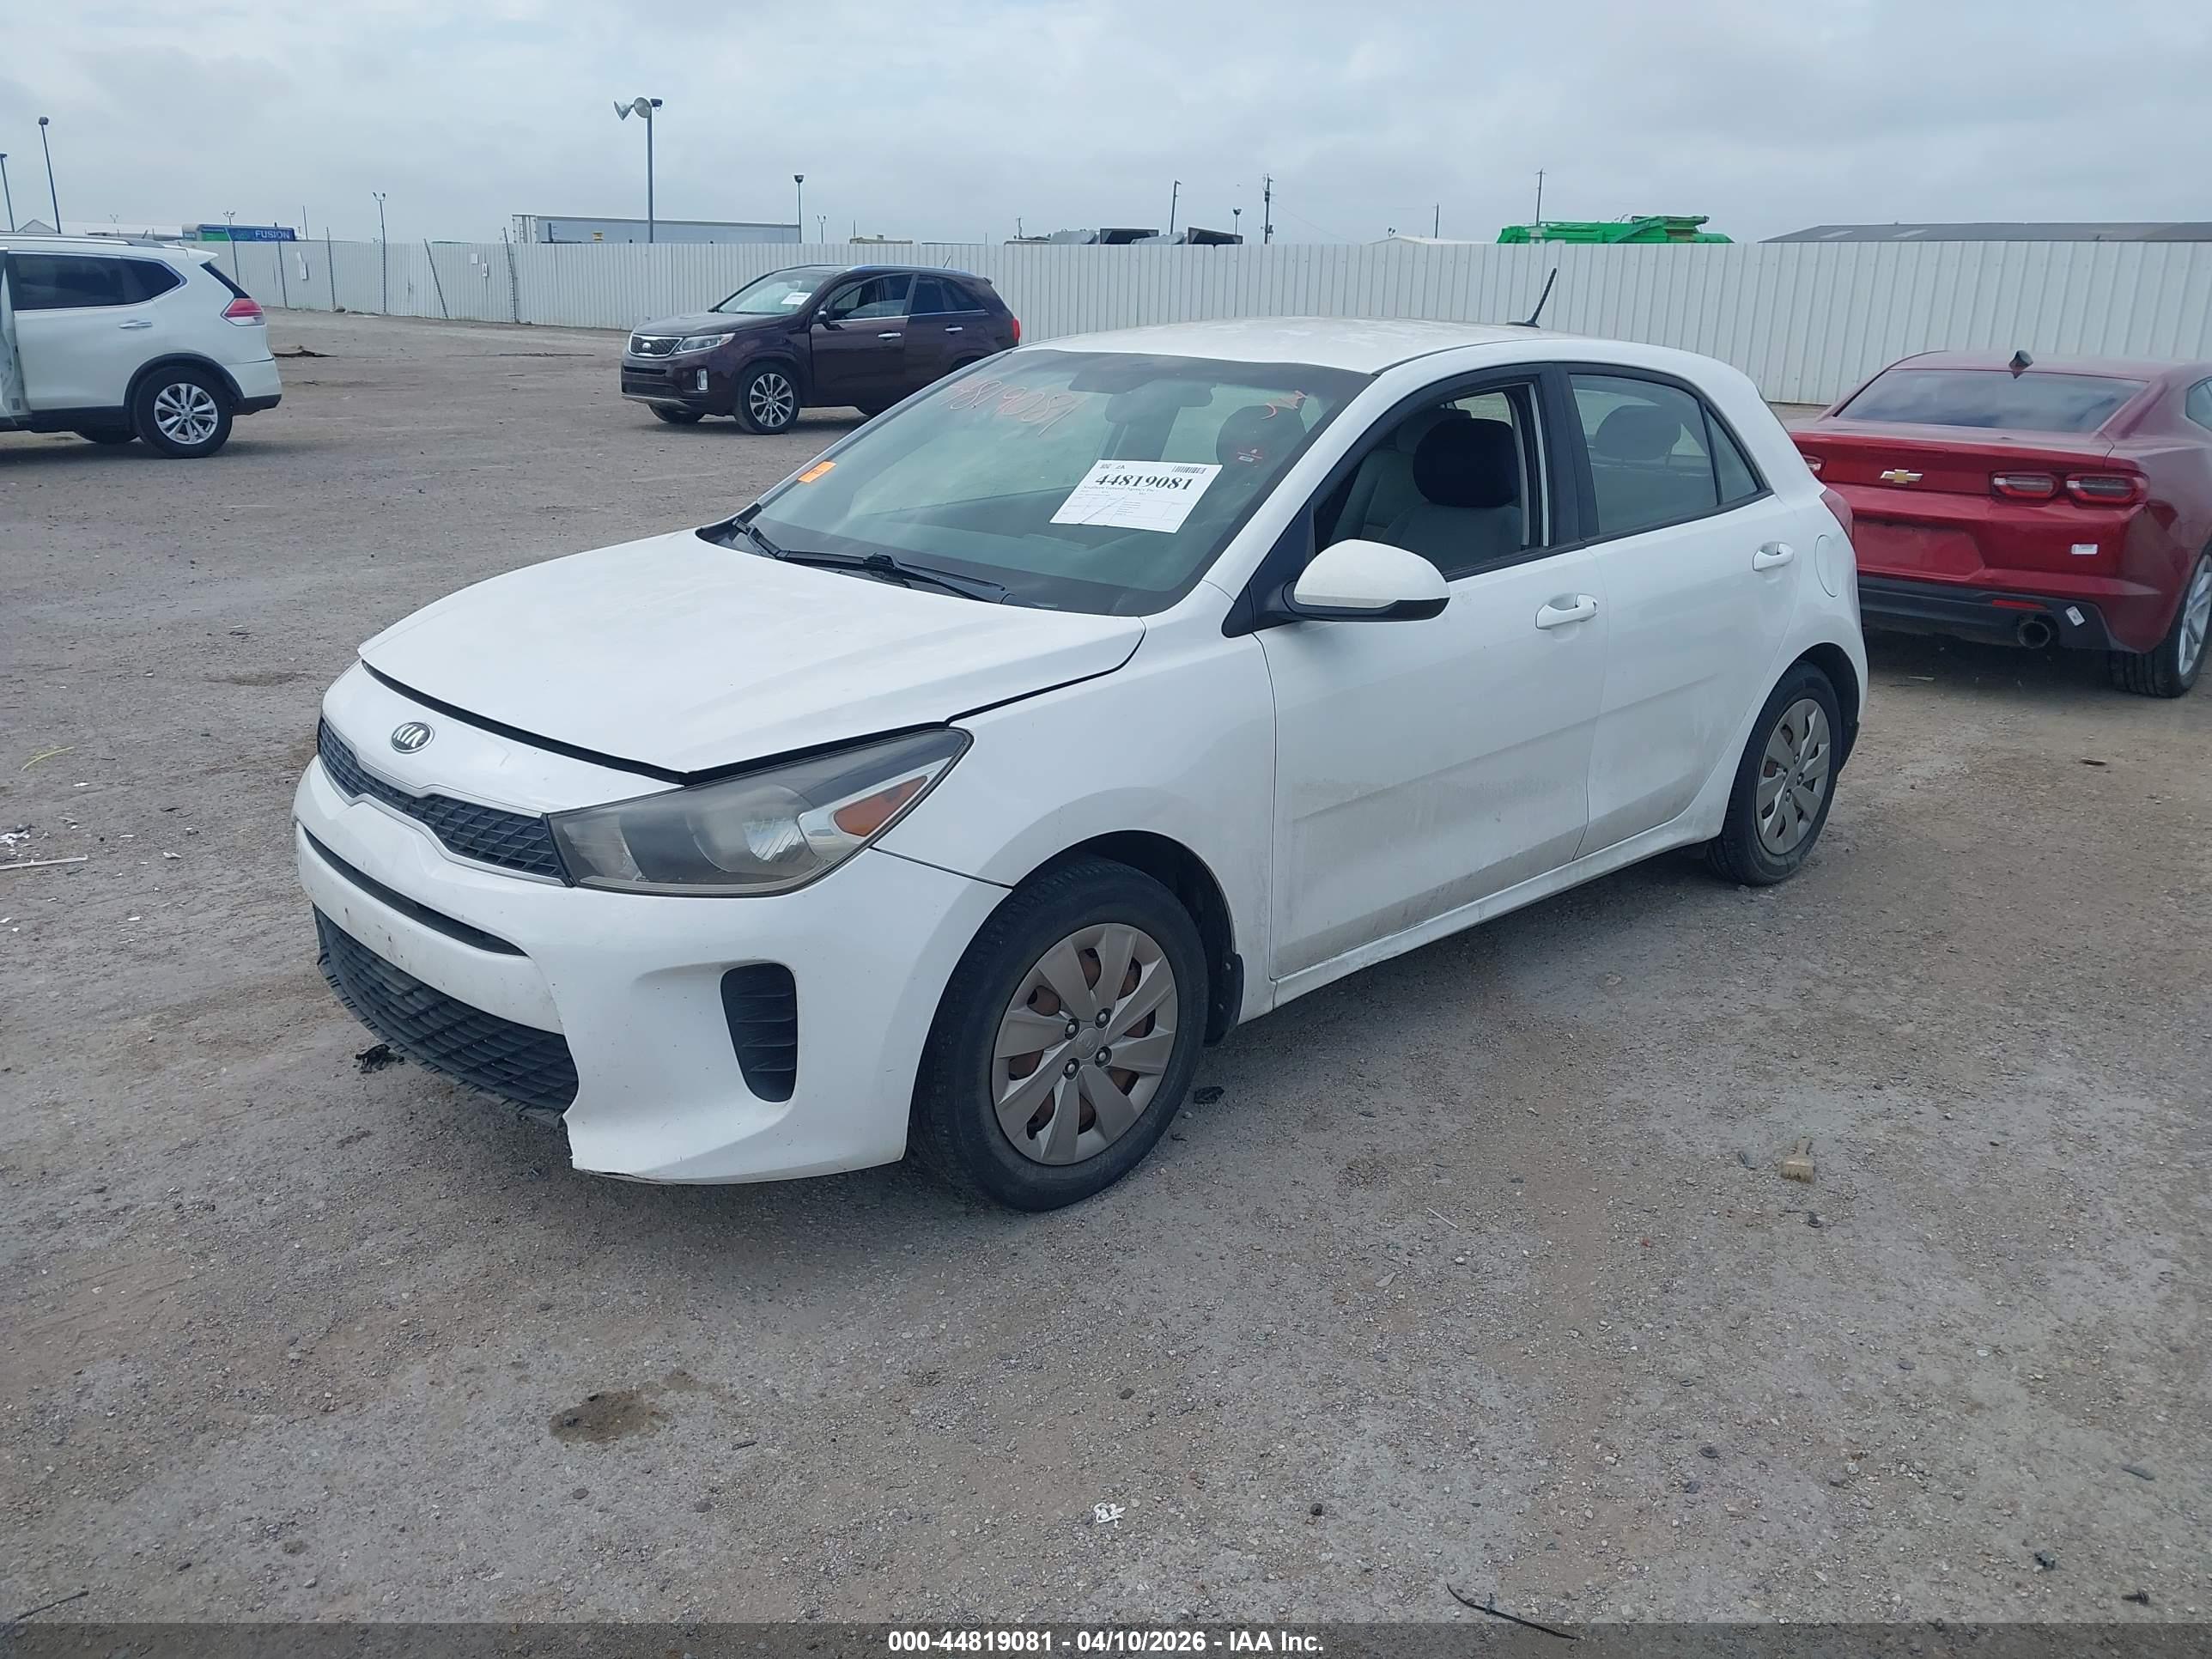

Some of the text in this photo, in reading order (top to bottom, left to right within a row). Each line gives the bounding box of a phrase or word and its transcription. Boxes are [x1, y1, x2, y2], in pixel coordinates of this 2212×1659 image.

[255, 229, 290, 240] FUSION
[1095, 474, 1194, 490] 44819081
[393, 724, 426, 748] KIA
